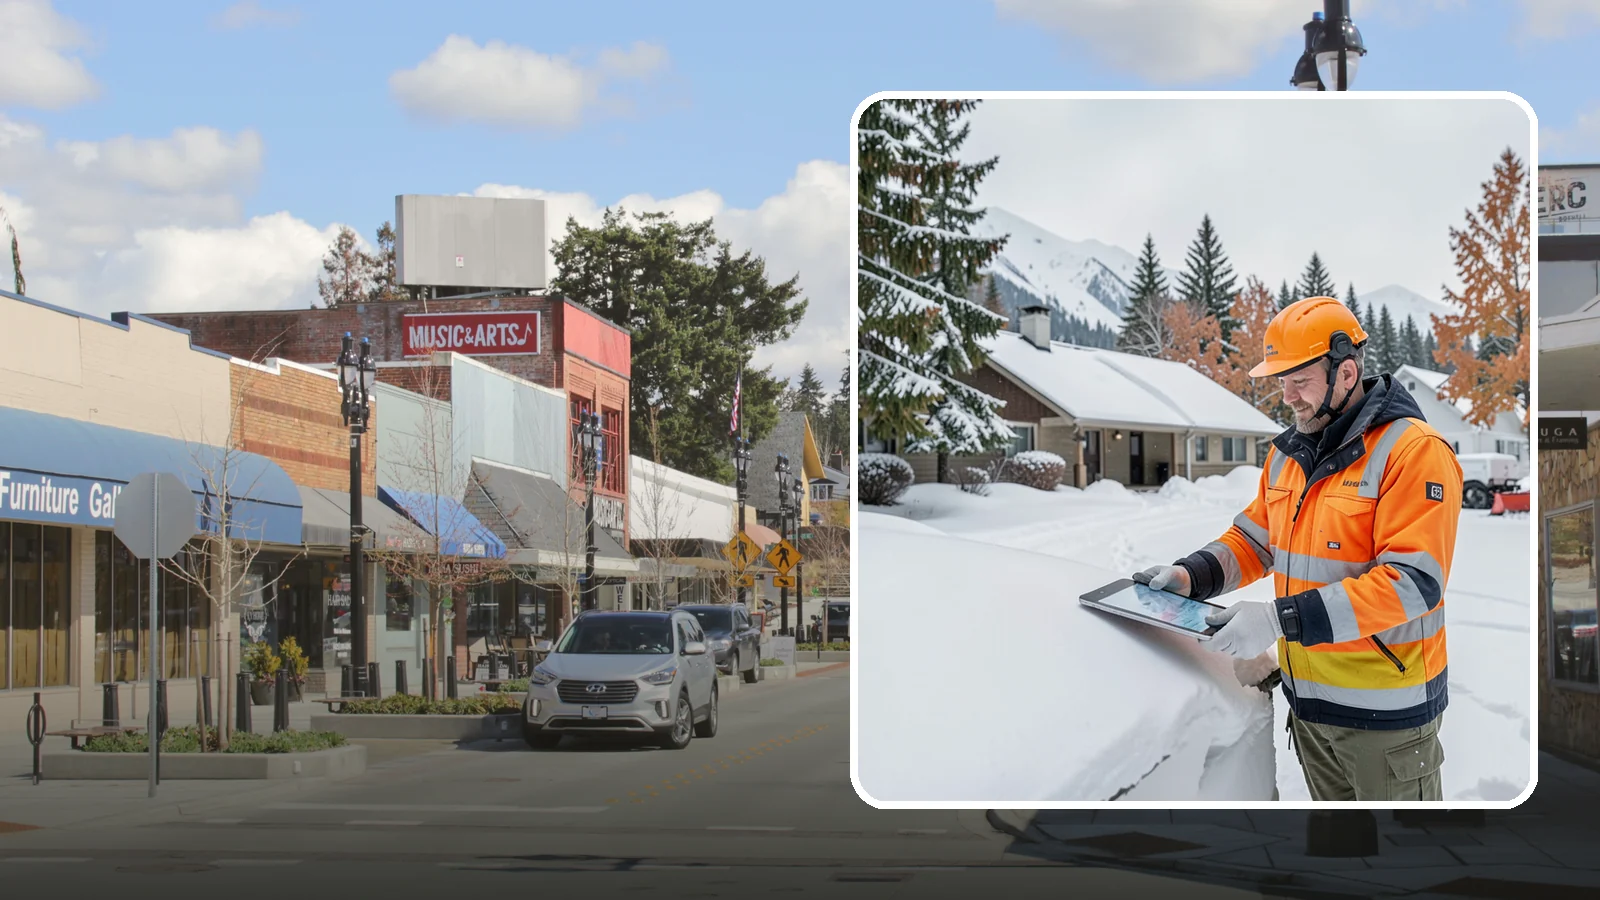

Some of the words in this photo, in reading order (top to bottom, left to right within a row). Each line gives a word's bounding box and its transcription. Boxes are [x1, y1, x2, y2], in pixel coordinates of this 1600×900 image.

[409, 323, 520, 349] MUSIC&ARTS
[0, 471, 79, 515] Furniture
[89, 482, 122, 519] Gal
